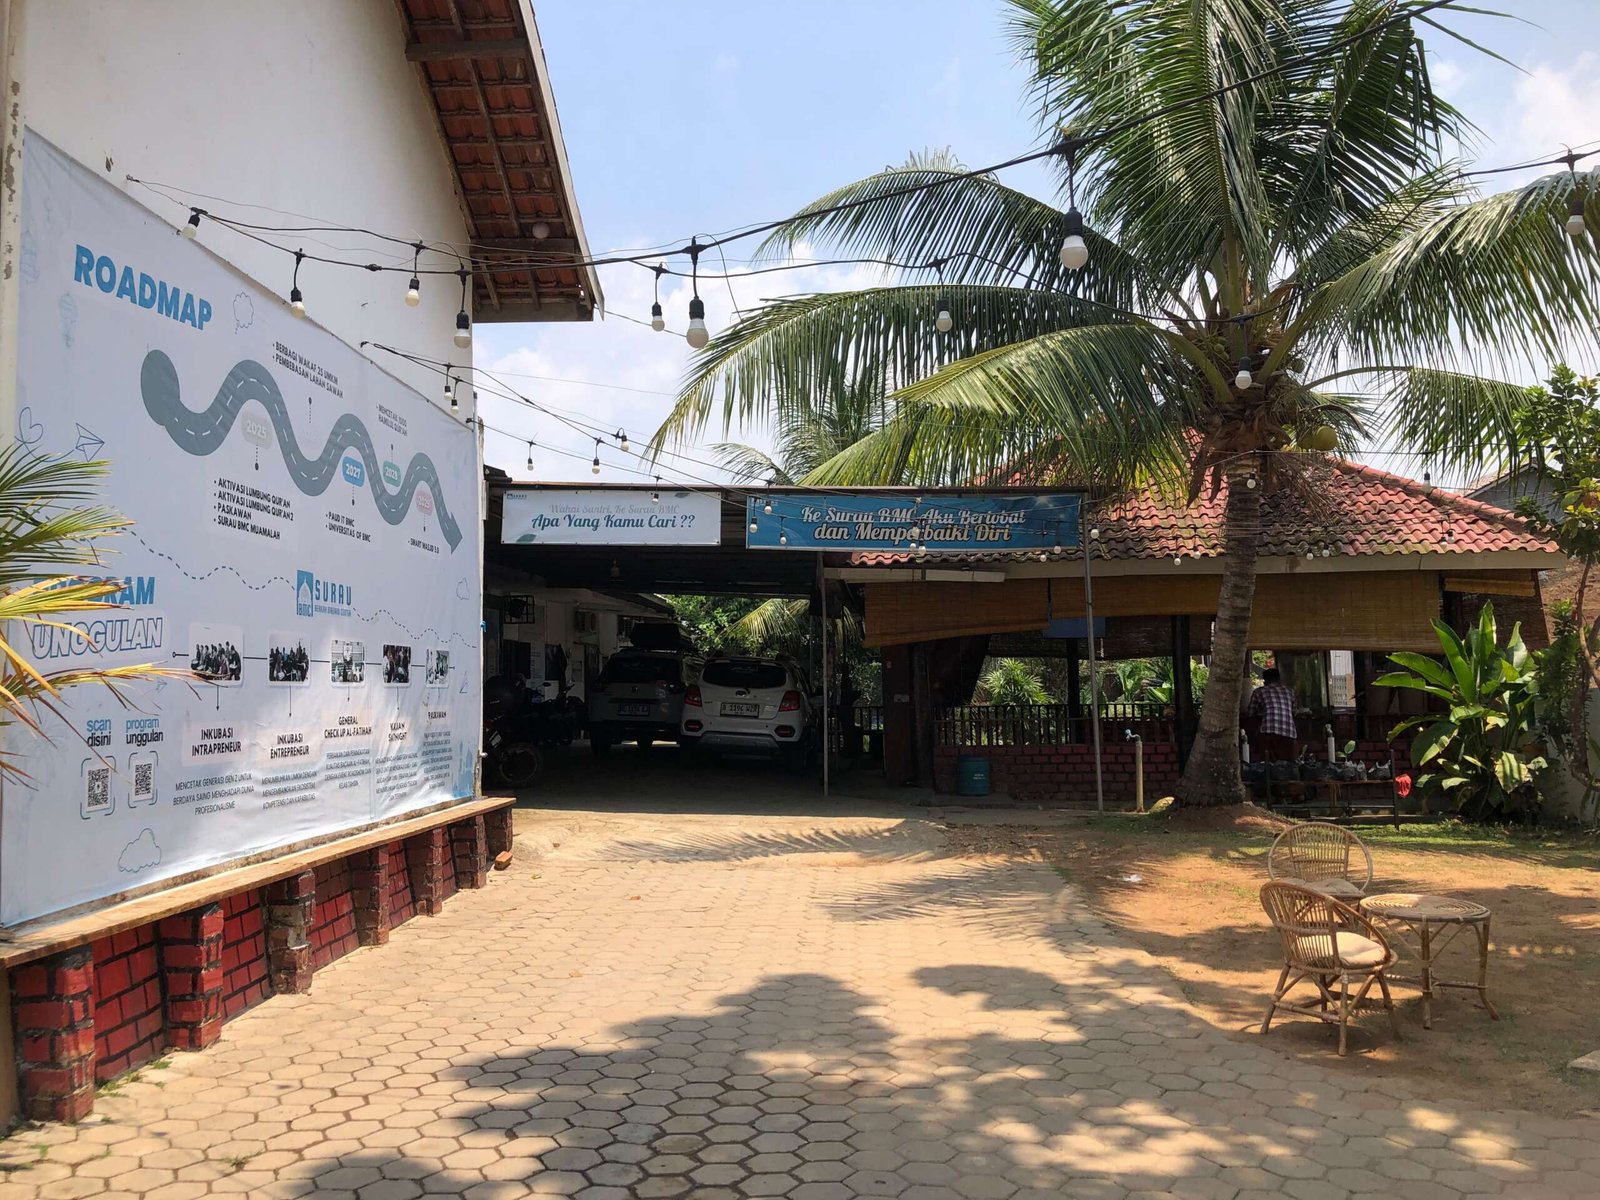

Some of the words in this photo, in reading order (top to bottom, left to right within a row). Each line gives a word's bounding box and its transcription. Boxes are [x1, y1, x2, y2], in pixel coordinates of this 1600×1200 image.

[74, 244, 212, 330] ROADMAP
[275, 341, 298, 361] BERBAGI
[298, 354, 316, 372] WAKAF
[317, 366, 323, 376] 25
[275, 353, 309, 379] PEMBEBASAN
[246, 420, 267, 439] 2025
[345, 463, 361, 479] 2027
[218, 477, 245, 494] AKTIVASI
[246, 486, 271, 503] LUMBUNG
[271, 495, 291, 508] QUR'AN
[217, 502, 252, 520] PASKAWAN
[218, 490, 245, 507] AKTIVASI
[246, 499, 271, 514] LUMBUNG
[657, 504, 680, 514] BMC
[328, 511, 340, 522] PAUD
[345, 517, 354, 527] BMC
[531, 514, 560, 531] Apa
[563, 514, 601, 532] Yang
[603, 514, 645, 528] Kamu
[648, 514, 677, 528] Cari
[680, 514, 696, 528] ??
[801, 507, 822, 523] Ke
[825, 507, 874, 523] Surau
[877, 507, 917, 523] BMC
[920, 508, 955, 525] Aku
[958, 509, 1026, 525] Bertobat
[218, 515, 237, 529] SURAU
[237, 520, 249, 532] BMC
[250, 523, 280, 540] MUAMALAH
[328, 523, 355, 538] UNIVERSITAS
[362, 533, 371, 542] BMC
[814, 523, 850, 540] dan
[975, 523, 1012, 541] Diri
[315, 579, 352, 606] SURAU
[32, 617, 163, 660] UNGGULAN
[86, 718, 112, 733] scan
[125, 717, 160, 733] program
[338, 715, 358, 726] GENERAL
[86, 731, 112, 748] disini
[126, 729, 164, 747] unggulan
[201, 727, 233, 741] INKUBASI
[276, 732, 303, 745] INKUBASI
[324, 728, 339, 739] CHECK
[191, 741, 242, 757] INTRAPRENEUR
[270, 745, 310, 759] ENTREPRENEUR
[175, 780, 202, 791] MENCETAK
[173, 794, 195, 806] BERDAYA
